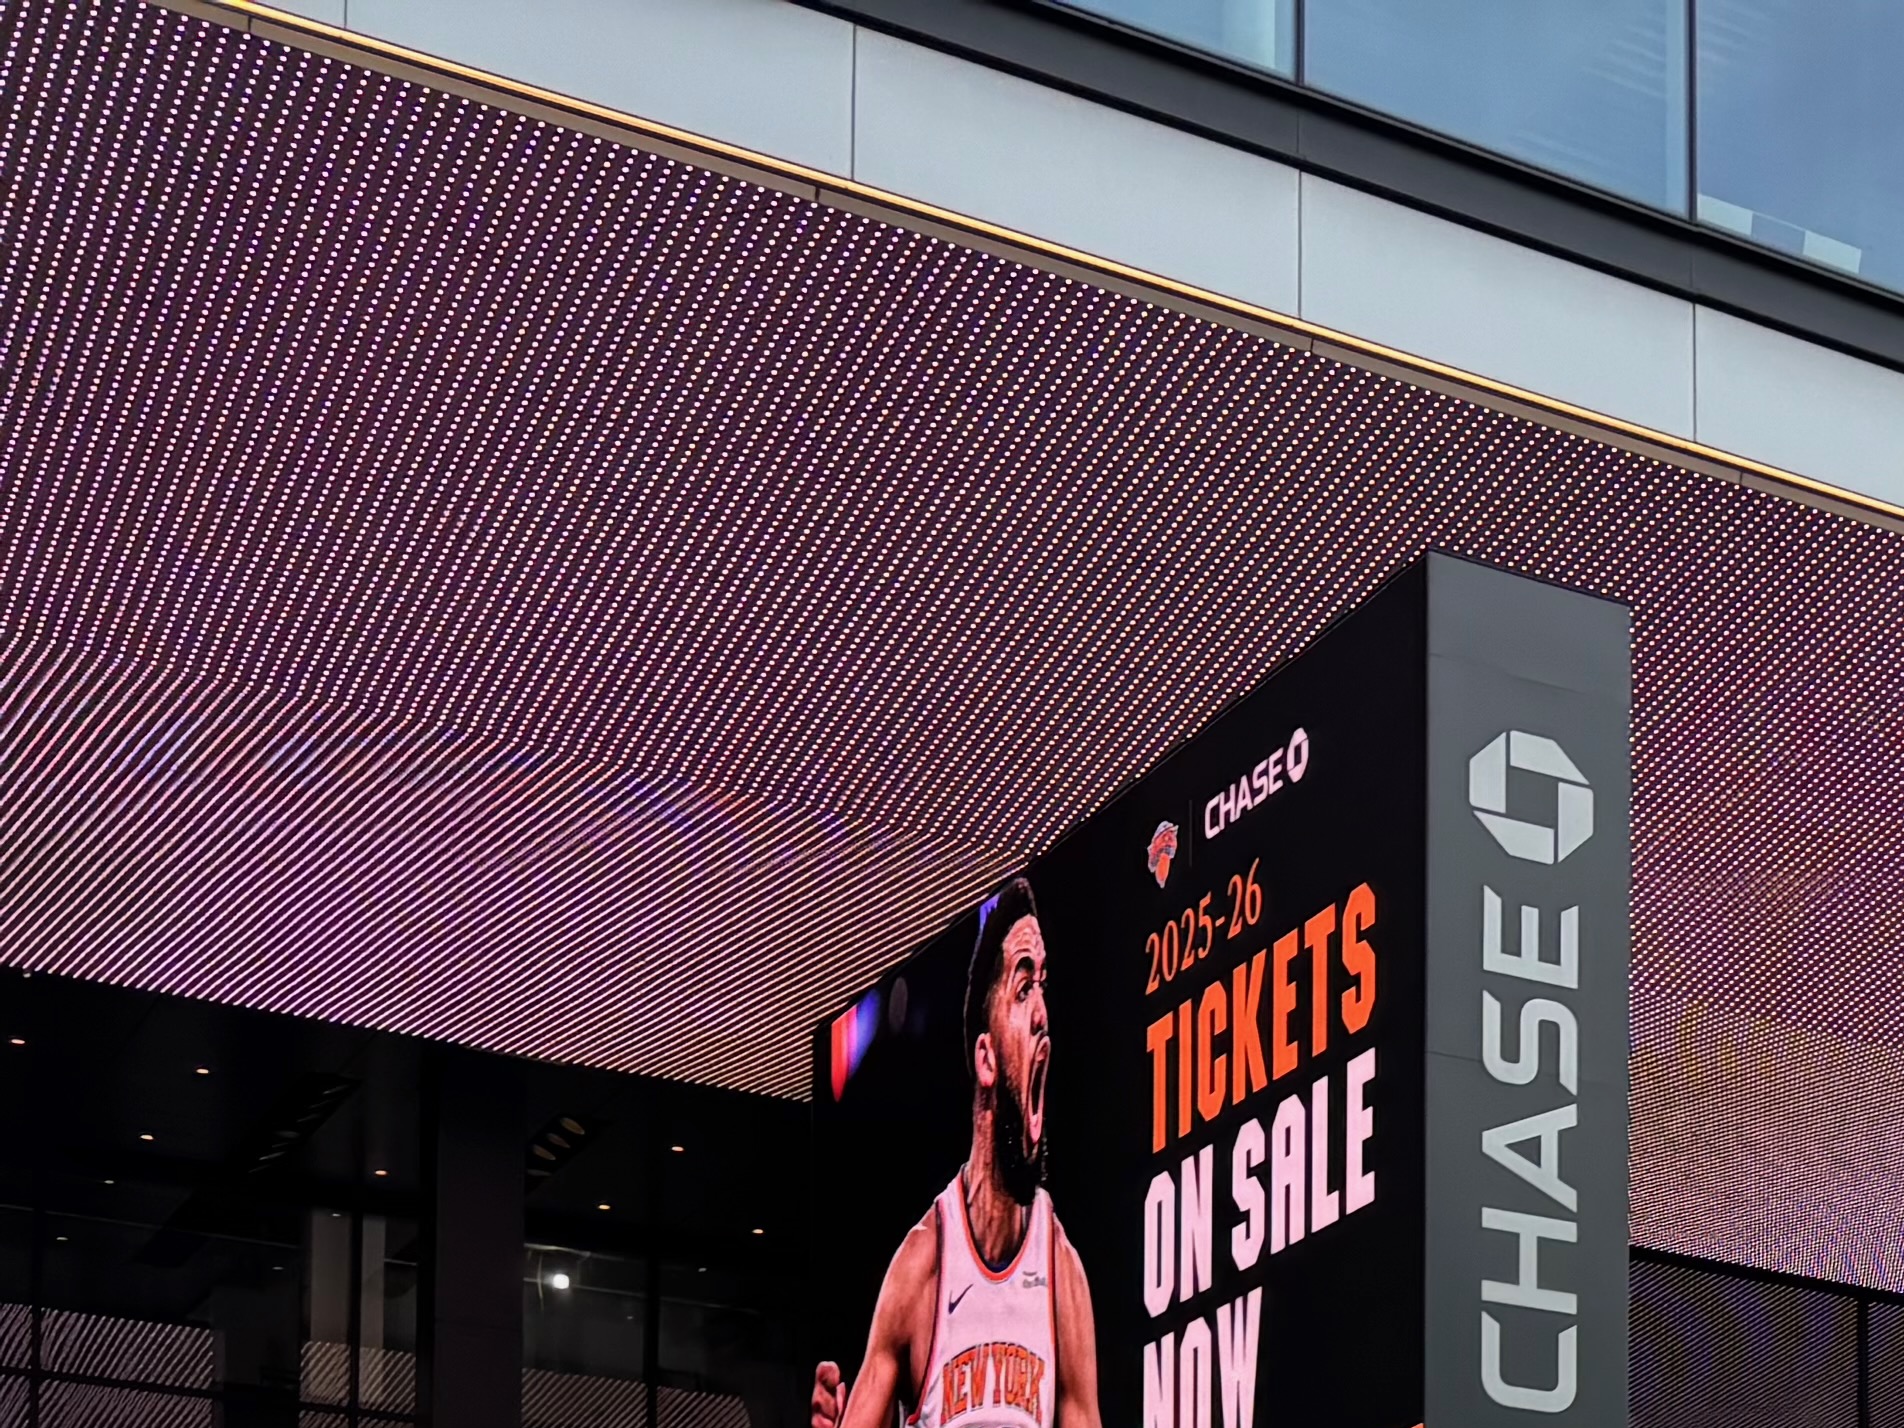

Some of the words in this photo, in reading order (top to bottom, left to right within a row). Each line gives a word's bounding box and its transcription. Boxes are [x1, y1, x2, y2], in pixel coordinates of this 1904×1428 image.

[1203, 760, 1285, 840] CHASE
[1145, 857, 1264, 996] 2025-26
[1146, 881, 1378, 1154] TICKETS
[1142, 1146, 1216, 1318] ON
[1231, 1047, 1377, 1272] SALE
[1481, 884, 1580, 1413] CHASE
[940, 1343, 985, 1427] NEW
[990, 1341, 1046, 1425] YORK
